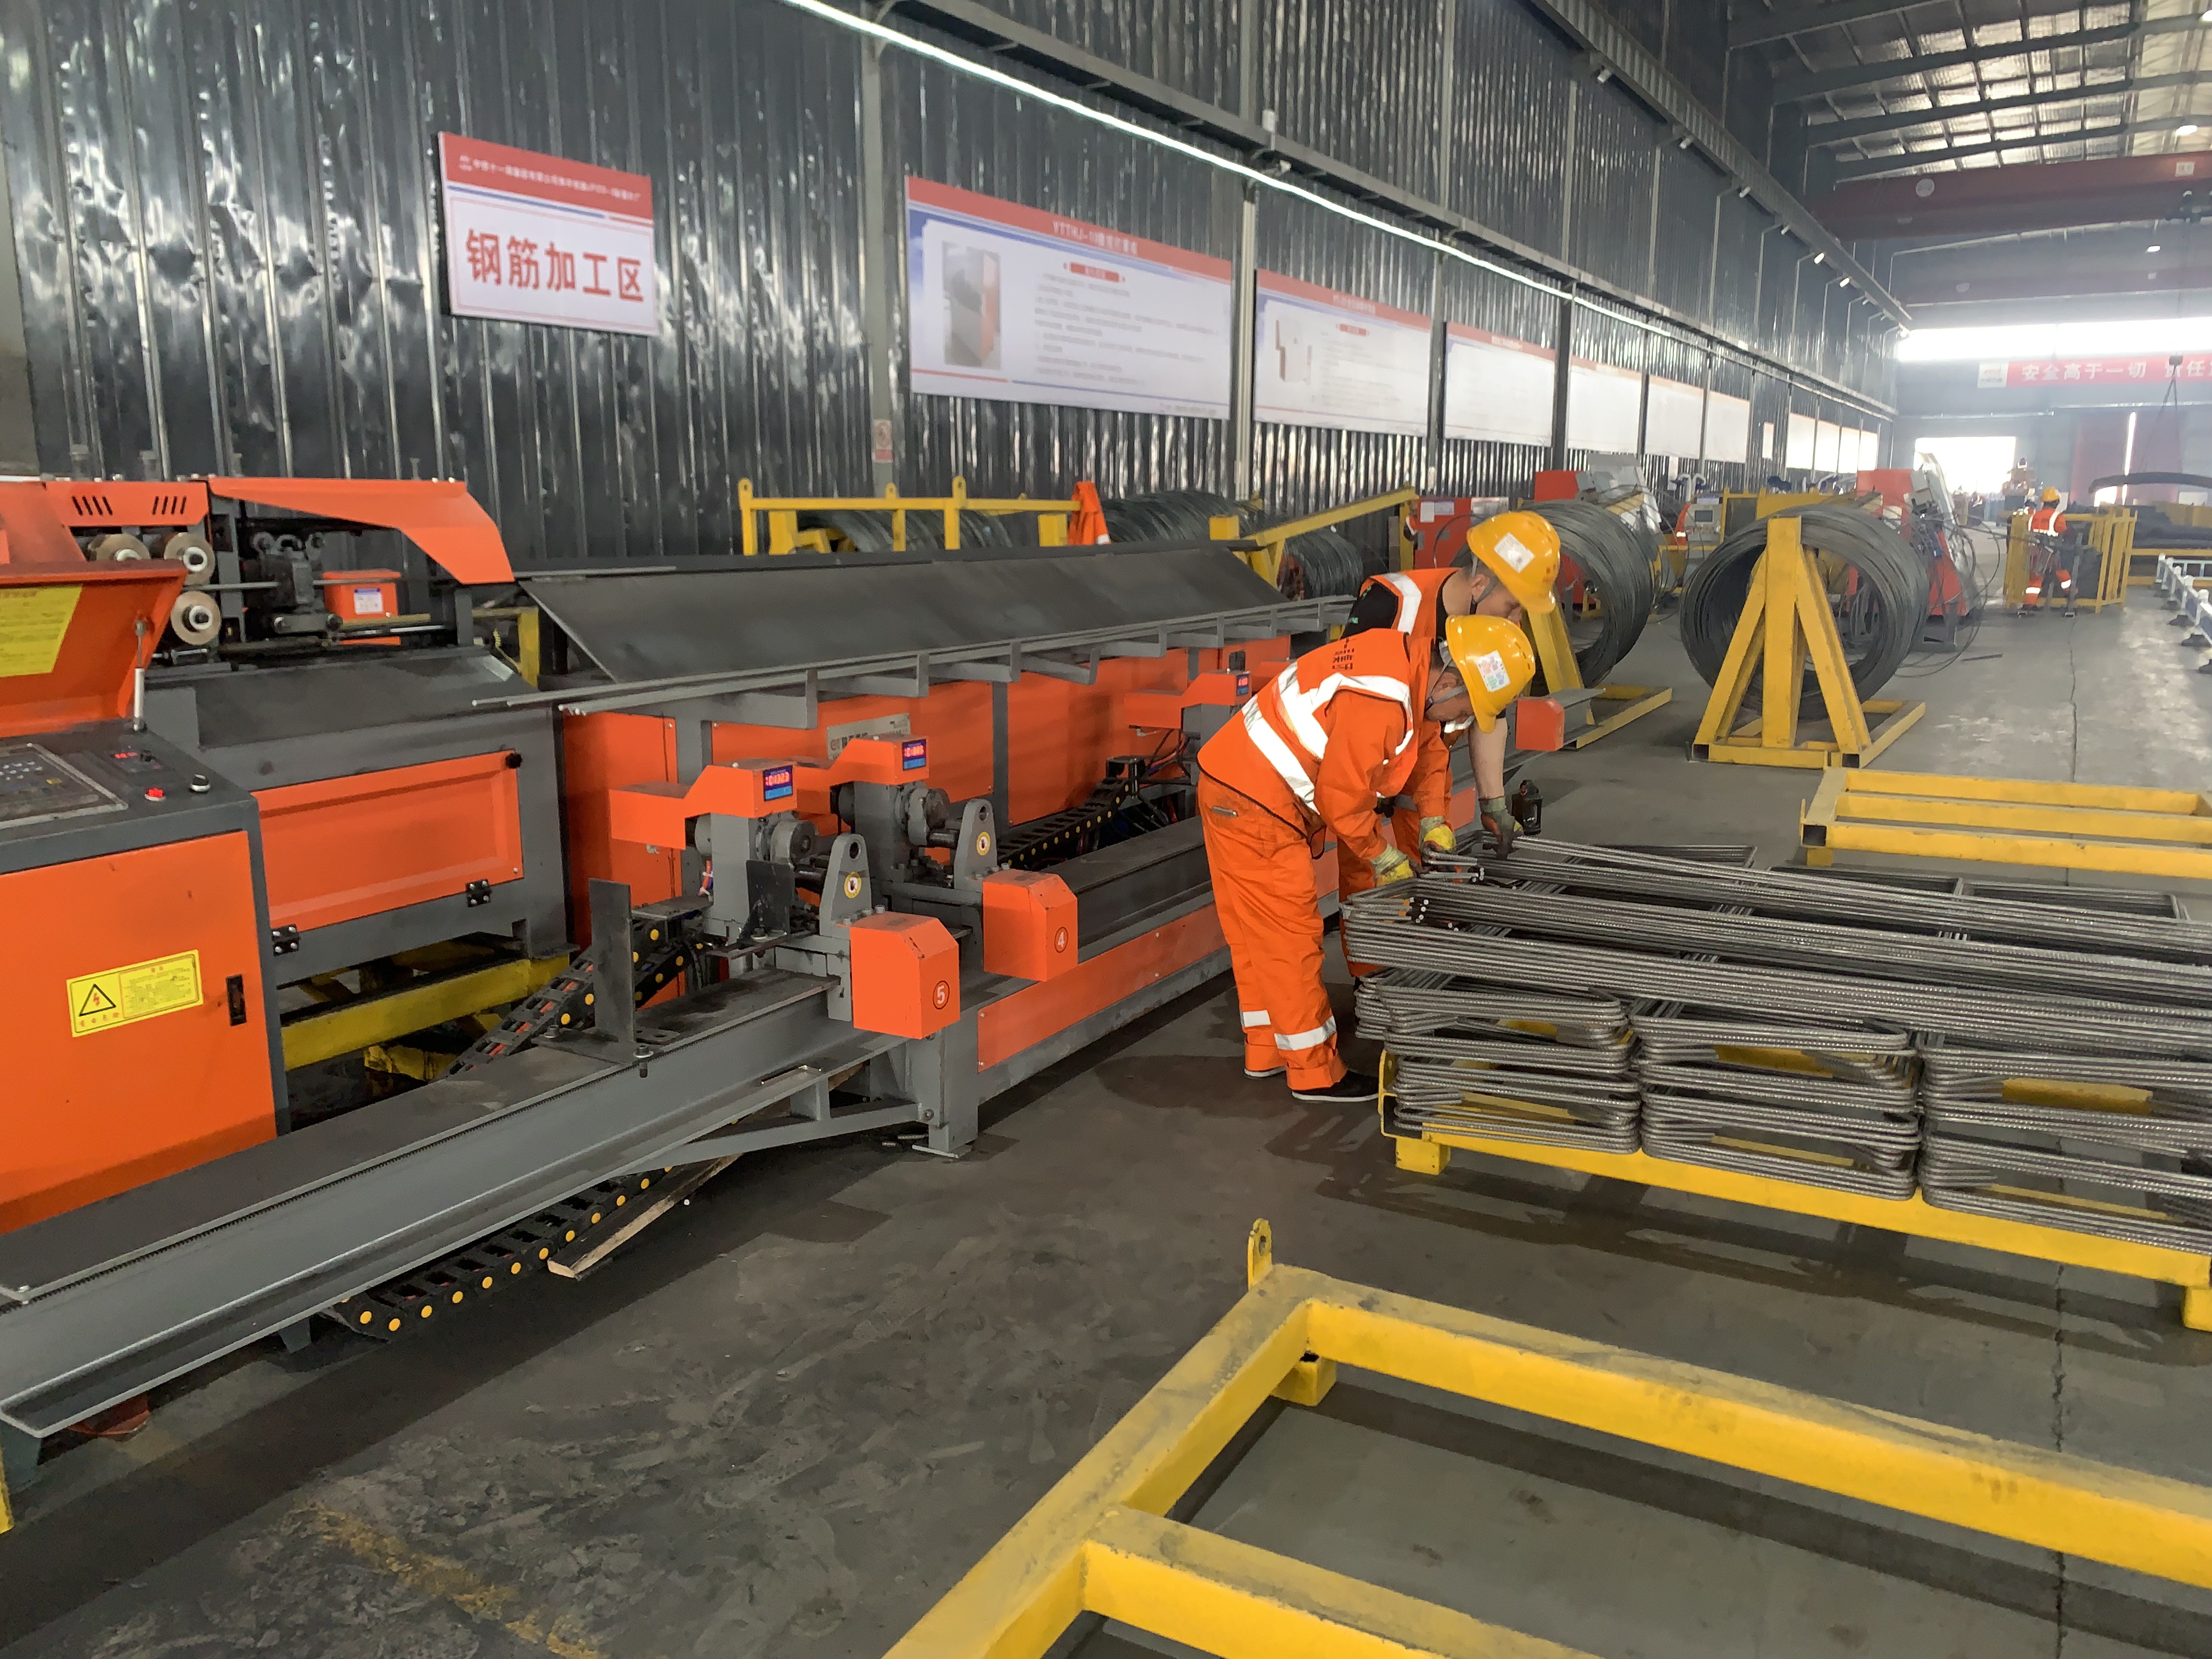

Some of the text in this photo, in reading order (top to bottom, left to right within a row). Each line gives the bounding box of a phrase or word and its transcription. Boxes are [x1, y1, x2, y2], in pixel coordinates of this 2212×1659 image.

[466, 228, 644, 302] 钢筋加工区
[2022, 363, 2146, 381] 安全高于一切
[2165, 360, 2212, 378] 责任
[1058, 932, 1065, 947] 4
[937, 985, 945, 1005] 5
